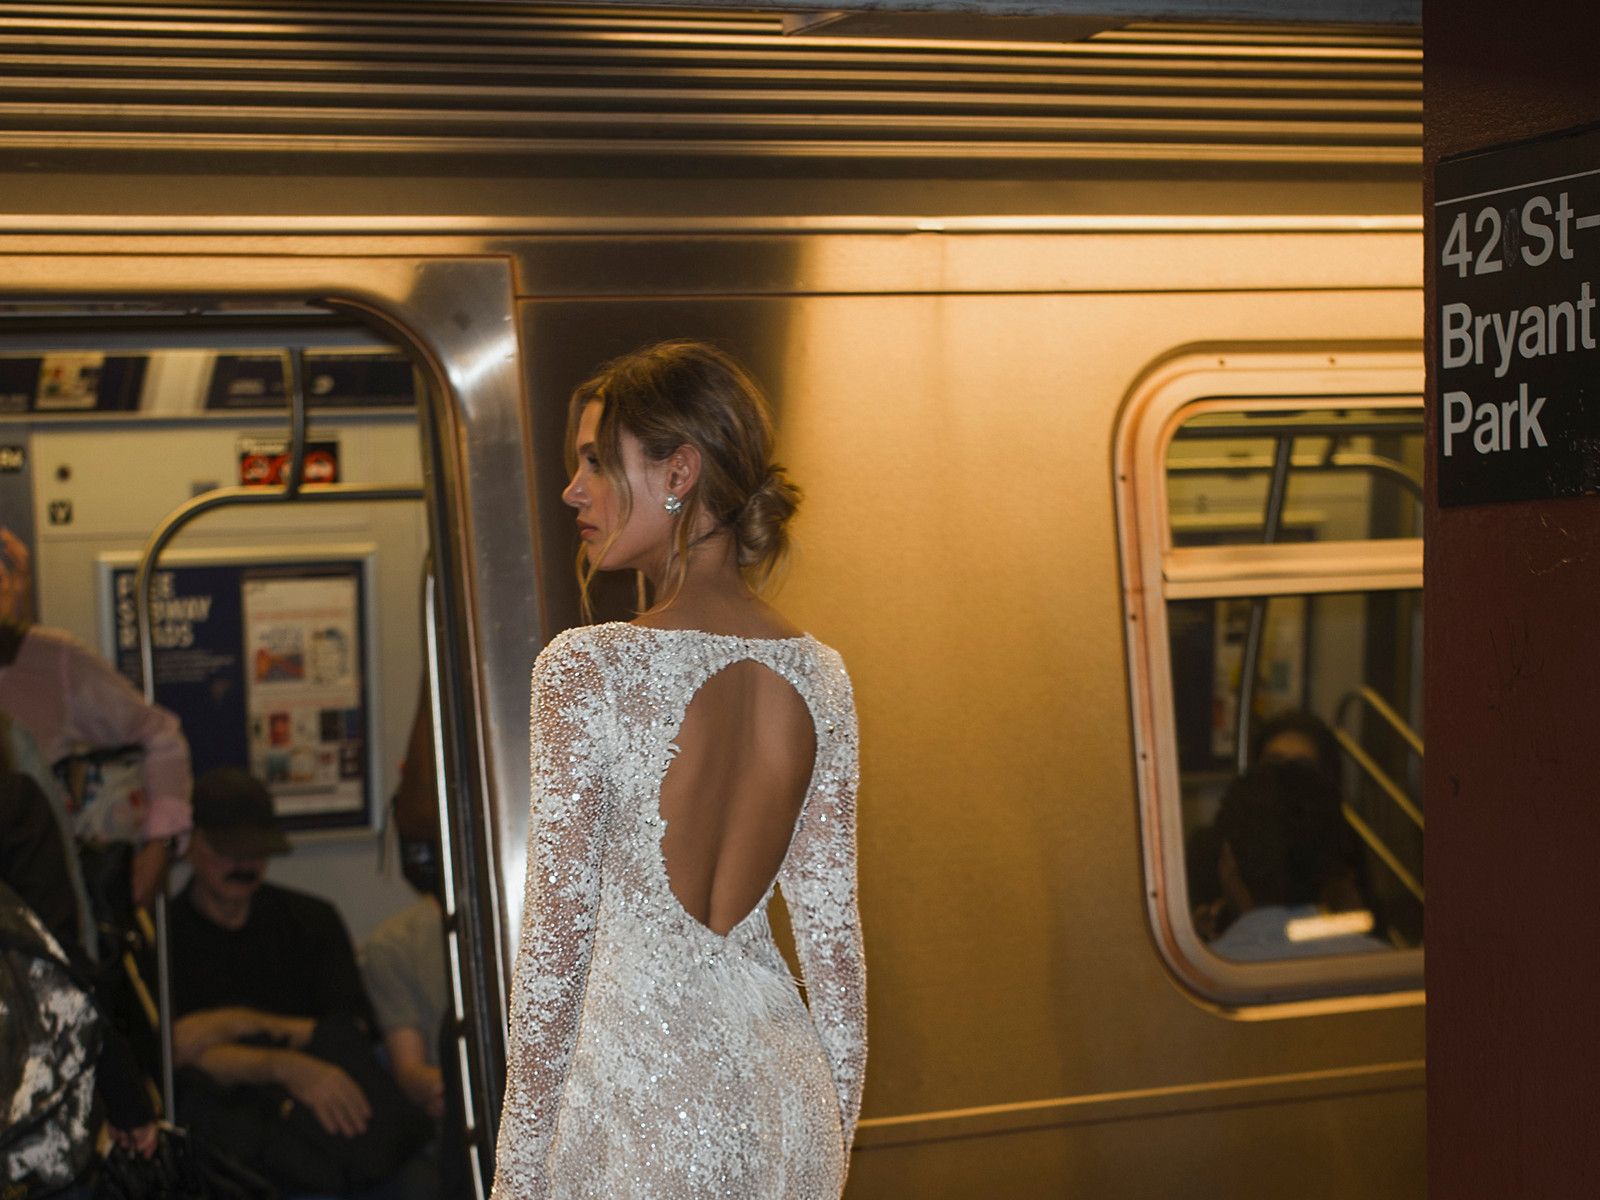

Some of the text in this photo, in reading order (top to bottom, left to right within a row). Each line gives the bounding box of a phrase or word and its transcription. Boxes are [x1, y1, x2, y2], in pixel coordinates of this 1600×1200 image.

[1442, 206, 1503, 278] 42
[1442, 282, 1596, 378] Bryant
[1443, 383, 1548, 457] Park
[117, 595, 212, 626] SBWAY
[119, 622, 195, 649] RADS
